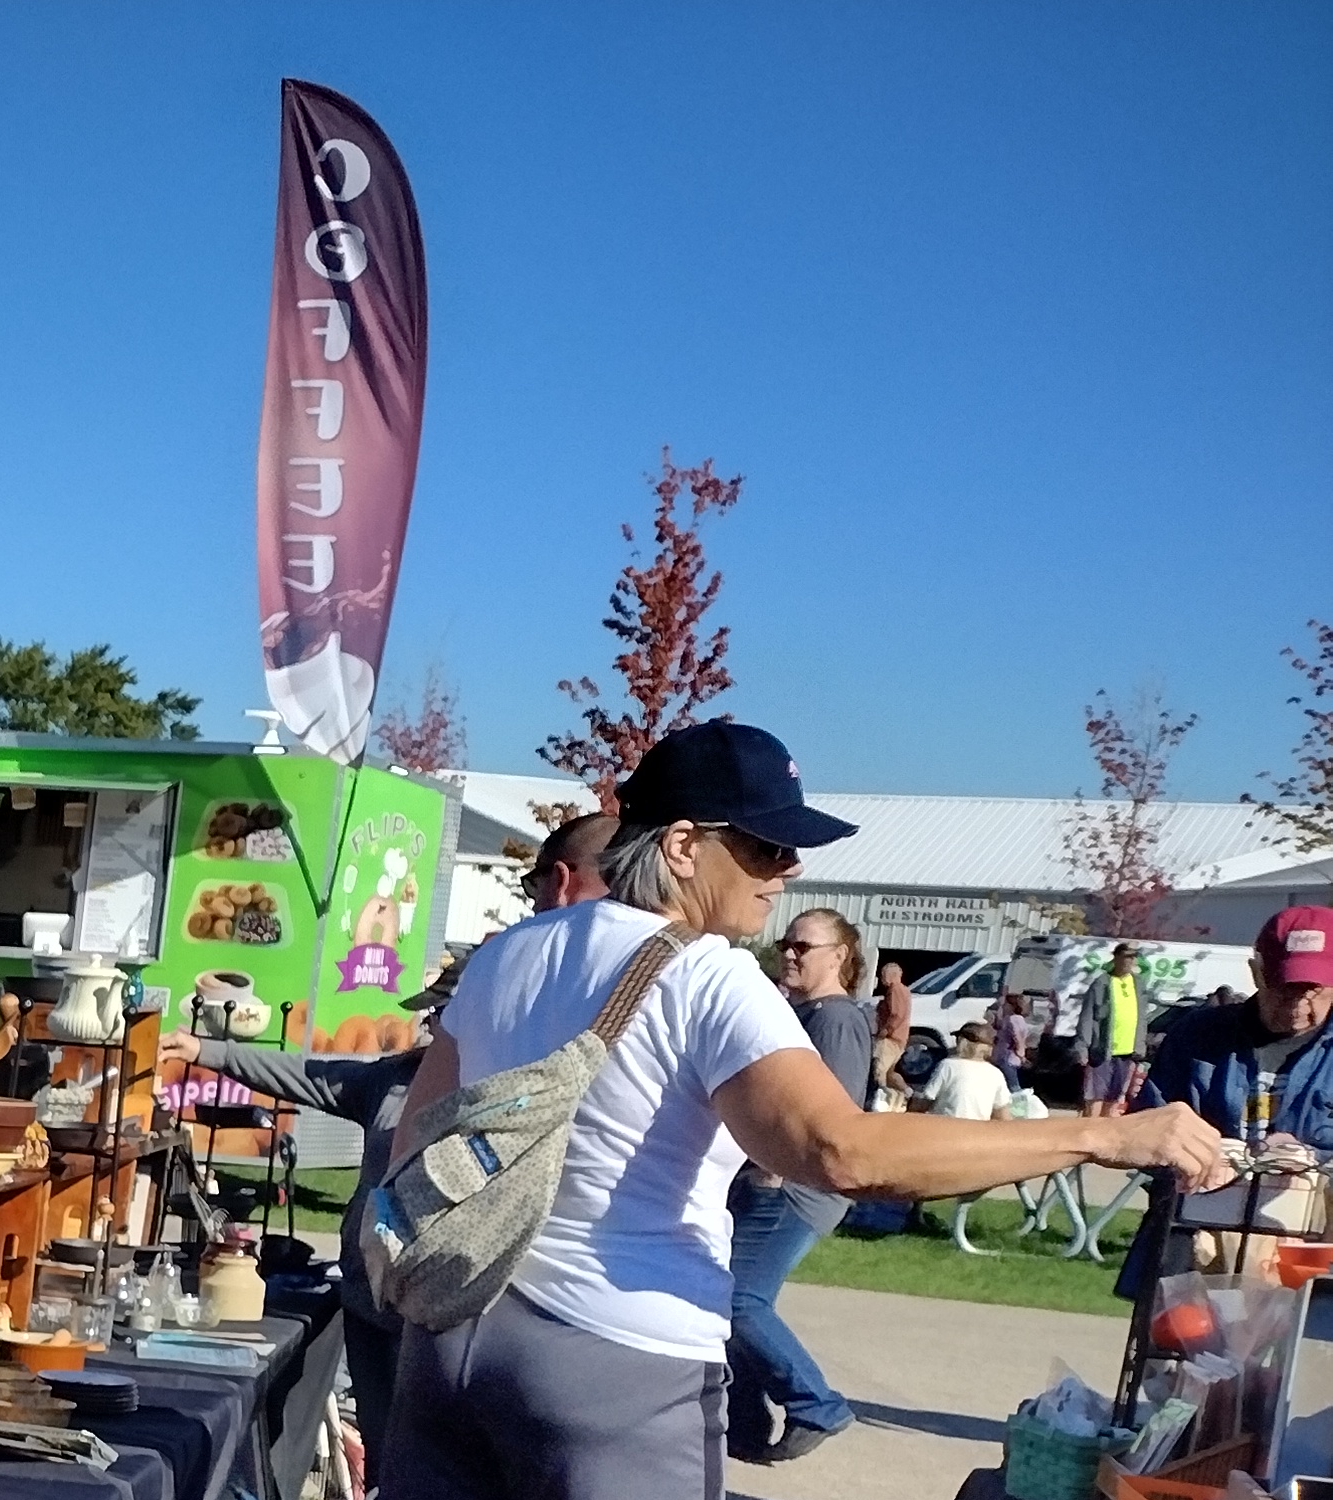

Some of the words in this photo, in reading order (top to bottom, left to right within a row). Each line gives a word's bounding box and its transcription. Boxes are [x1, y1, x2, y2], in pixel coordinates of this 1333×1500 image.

[350, 812, 427, 858] FLIP'S
[881, 896, 939, 908] NORTH
[946, 898, 984, 910] HALL
[879, 910, 985, 924] RESTROOMS
[364, 947, 385, 965] MINI
[353, 964, 389, 985] DONUTS
